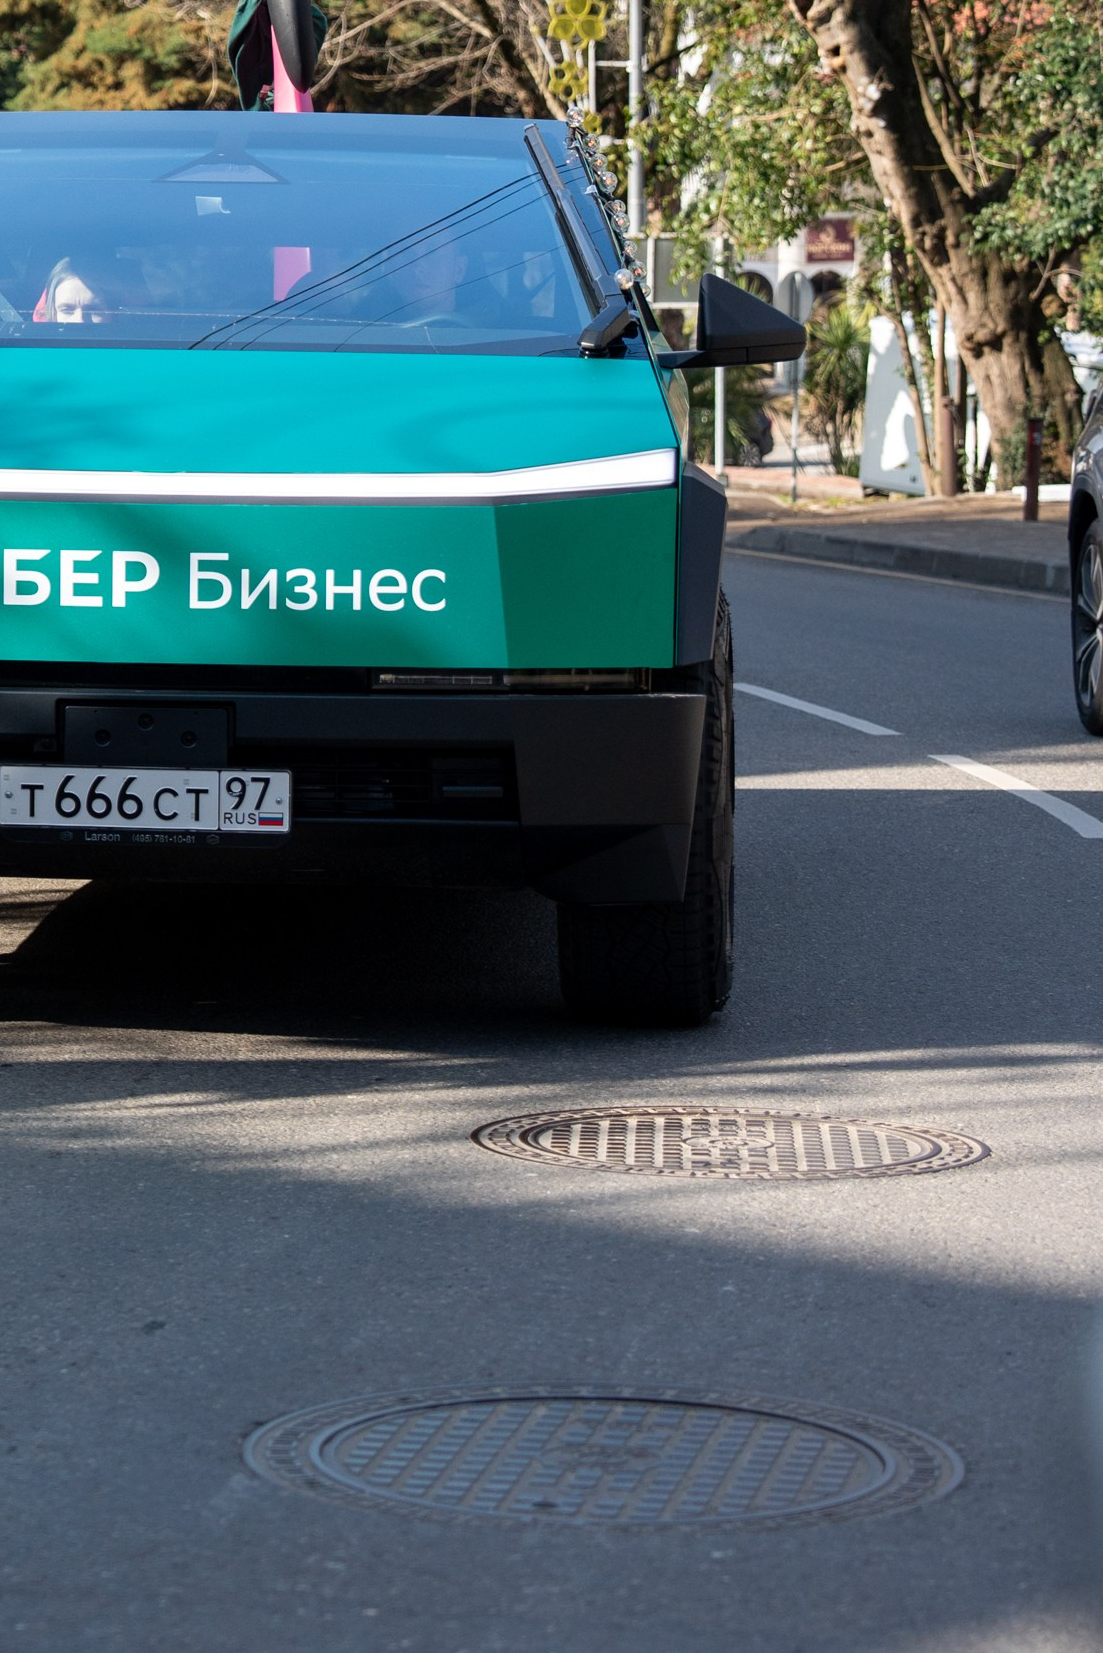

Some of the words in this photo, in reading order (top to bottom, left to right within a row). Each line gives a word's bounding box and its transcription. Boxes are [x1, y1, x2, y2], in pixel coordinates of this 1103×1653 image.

[189, 552, 446, 612] Бизнес
[225, 776, 271, 811] 97
[223, 812, 257, 825] RUS
[84, 831, 120, 842] Larson
